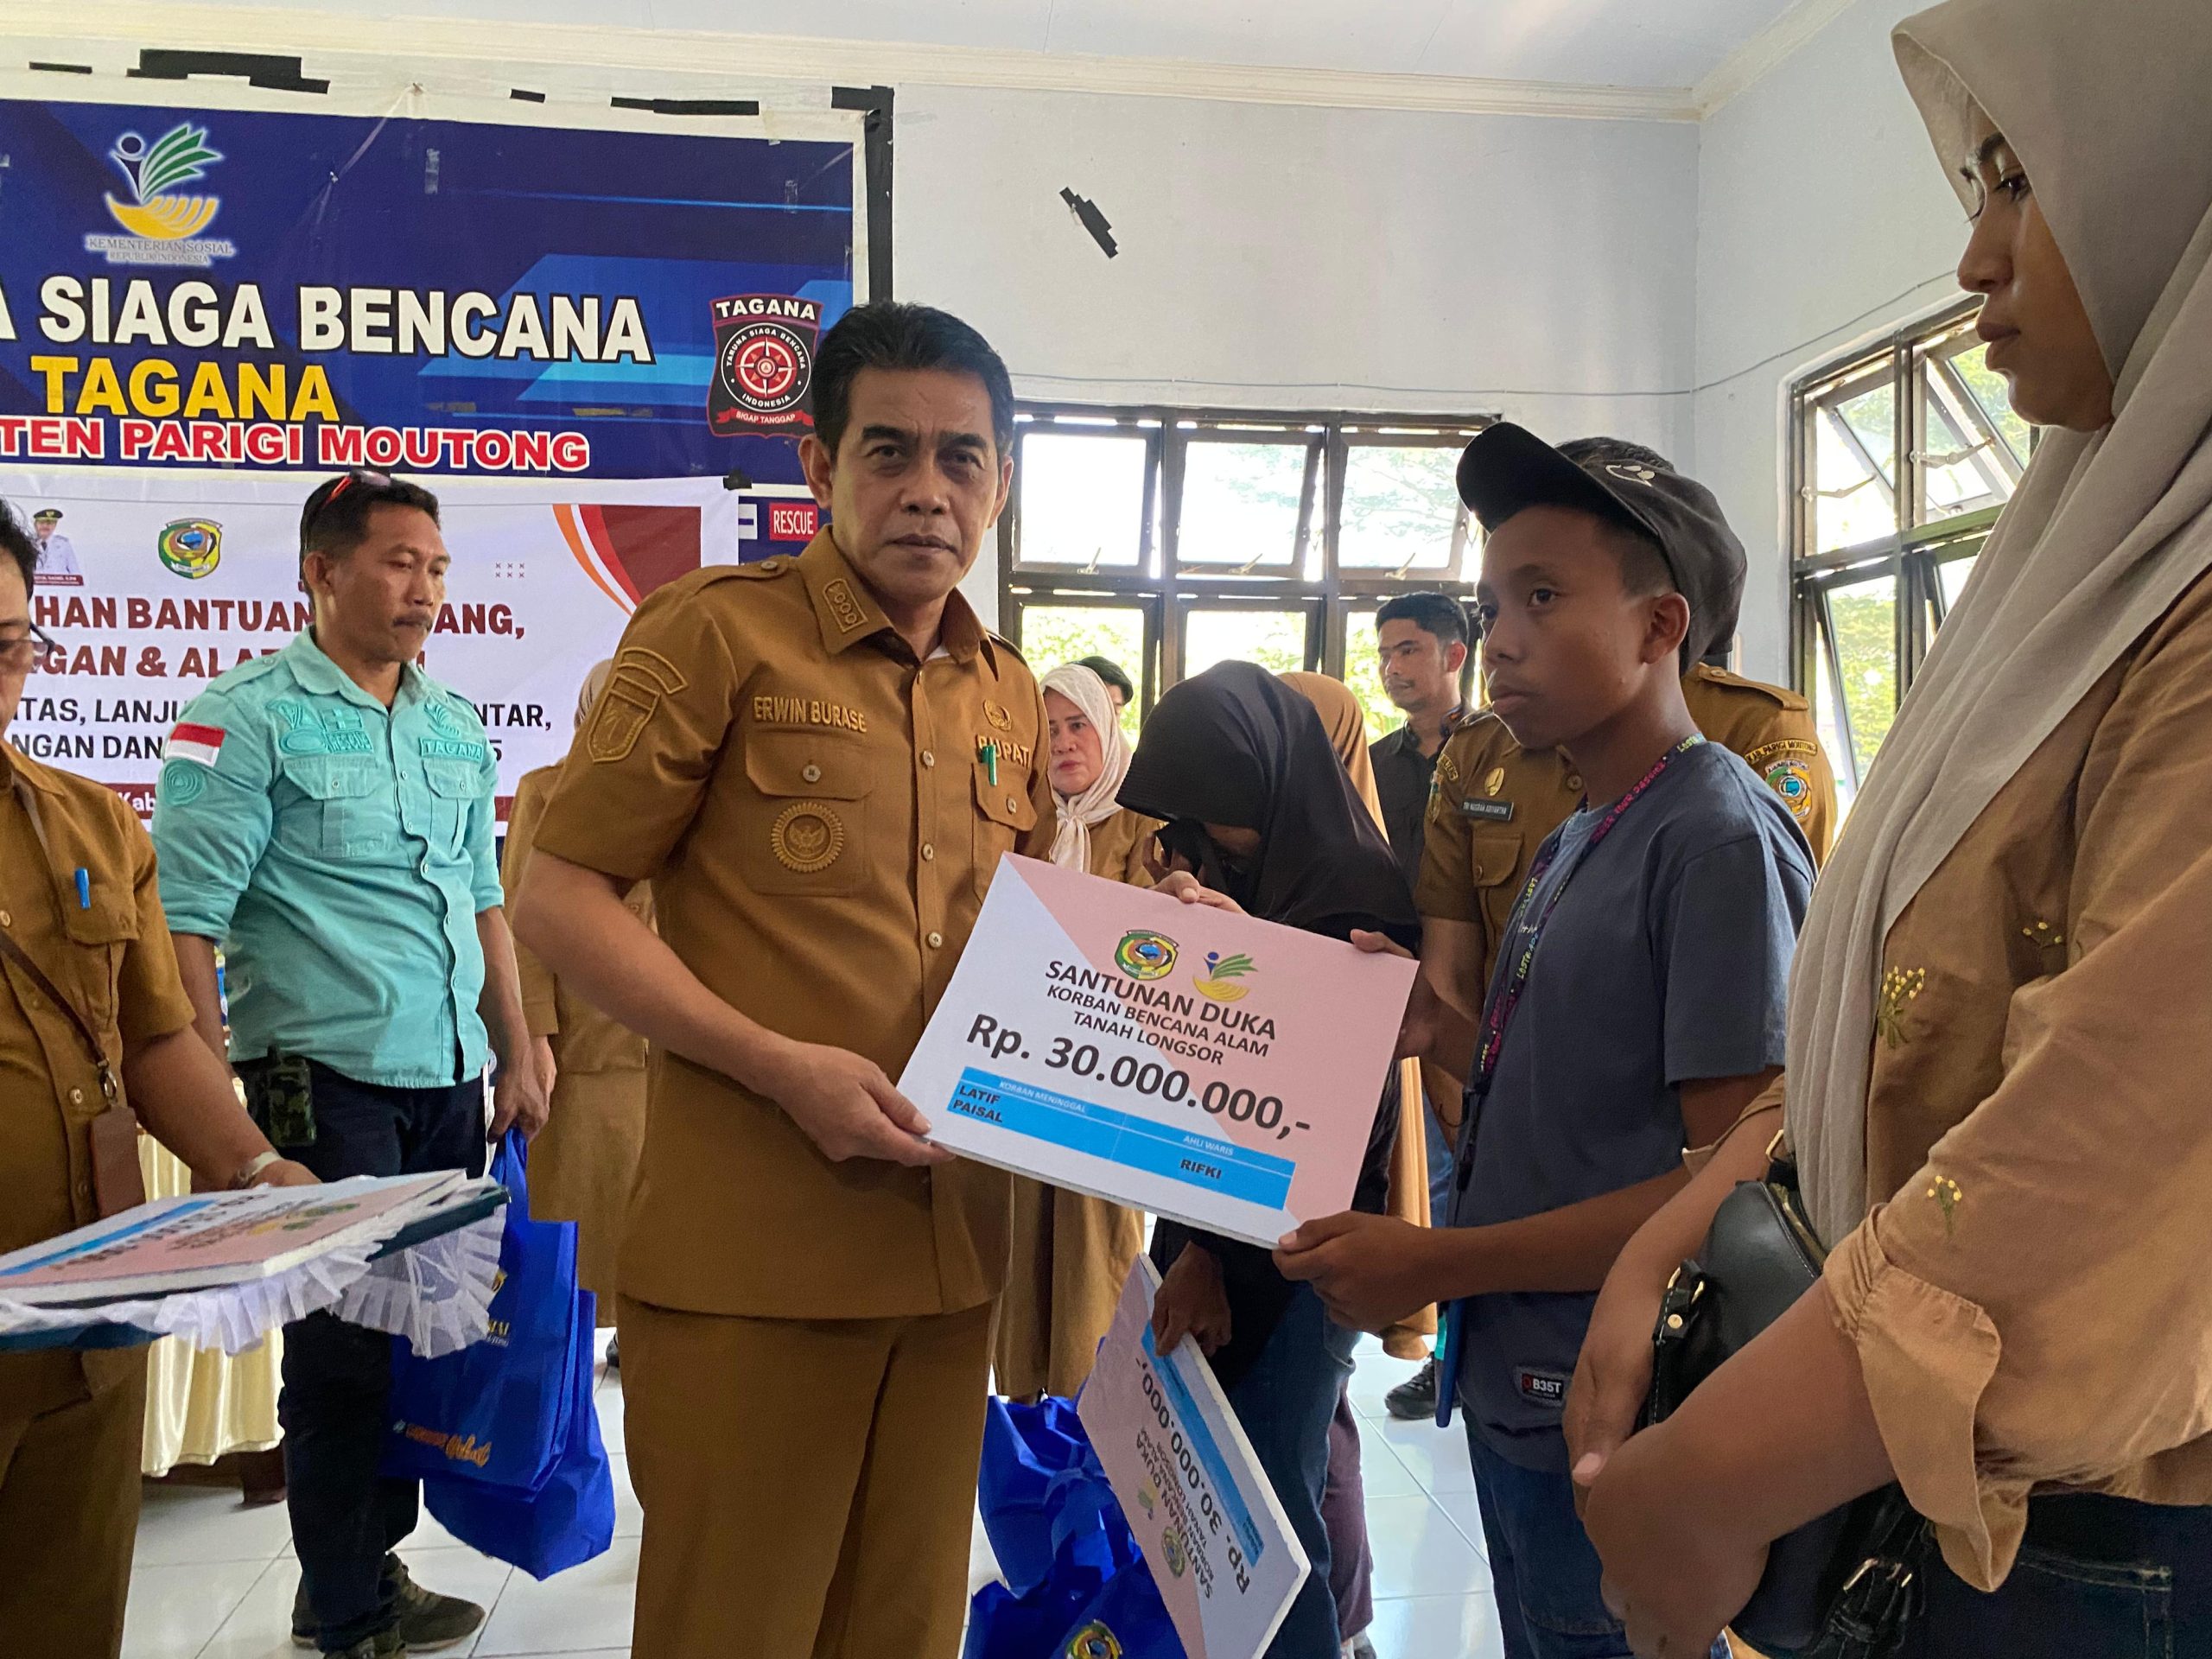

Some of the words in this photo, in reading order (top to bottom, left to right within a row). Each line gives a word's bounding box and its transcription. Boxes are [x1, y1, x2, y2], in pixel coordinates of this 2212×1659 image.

[89, 238, 184, 252] KEMENTERIAN
[186, 243, 232, 255] SOSIAL
[157, 253, 209, 264] INDONESIA
[40, 275, 274, 349] SIAGA
[300, 286, 654, 363] BENCANA
[716, 298, 816, 321] TAGANA
[749, 327, 777, 337] SIAGA
[780, 332, 806, 370] BENCANA
[31, 354, 340, 422] TAGANA
[741, 393, 791, 408] INDONESIA
[735, 410, 760, 423] SIGAP
[760, 413, 796, 424] TANGGAP
[120, 419, 303, 463] PARIGI
[319, 426, 590, 472] MOUTONG
[773, 510, 814, 535] RESCUE
[127, 597, 314, 632] BANTUAN
[136, 646, 167, 678] &
[753, 696, 806, 723] ERWIN
[810, 701, 867, 733] BURASE
[1046, 960, 1195, 1017] SANTUNAN
[1199, 1001, 1276, 1040] DUKA
[1046, 983, 1122, 1015] KORBAN
[1124, 1006, 1209, 1041] BENCANA
[1214, 1033, 1269, 1058] ALAM
[1073, 1010, 1133, 1039] TANAH
[1137, 1027, 1224, 1065] LONGSOR
[958, 1084, 1001, 1105] LATIF
[966, 1013, 1031, 1060] Rp.
[1044, 1036, 1311, 1141] 30.000.000,-
[952, 1098, 1003, 1123] PAISAL
[999, 1080, 1034, 1099] KORBAN
[1034, 1089, 1086, 1114] MENINGGAL
[1183, 1135, 1205, 1150] AHLI
[1204, 1140, 1234, 1157] WARIS
[1179, 1158, 1222, 1180] RIFKI
[1532, 1377, 1561, 1394] B35T
[1135, 1357, 1223, 1536] 30.000.000,-
[1136, 1433, 1161, 1488] DUKA
[1161, 1491, 1213, 1599] SANTUNAN
[1226, 1535, 1250, 1595] Rp.
